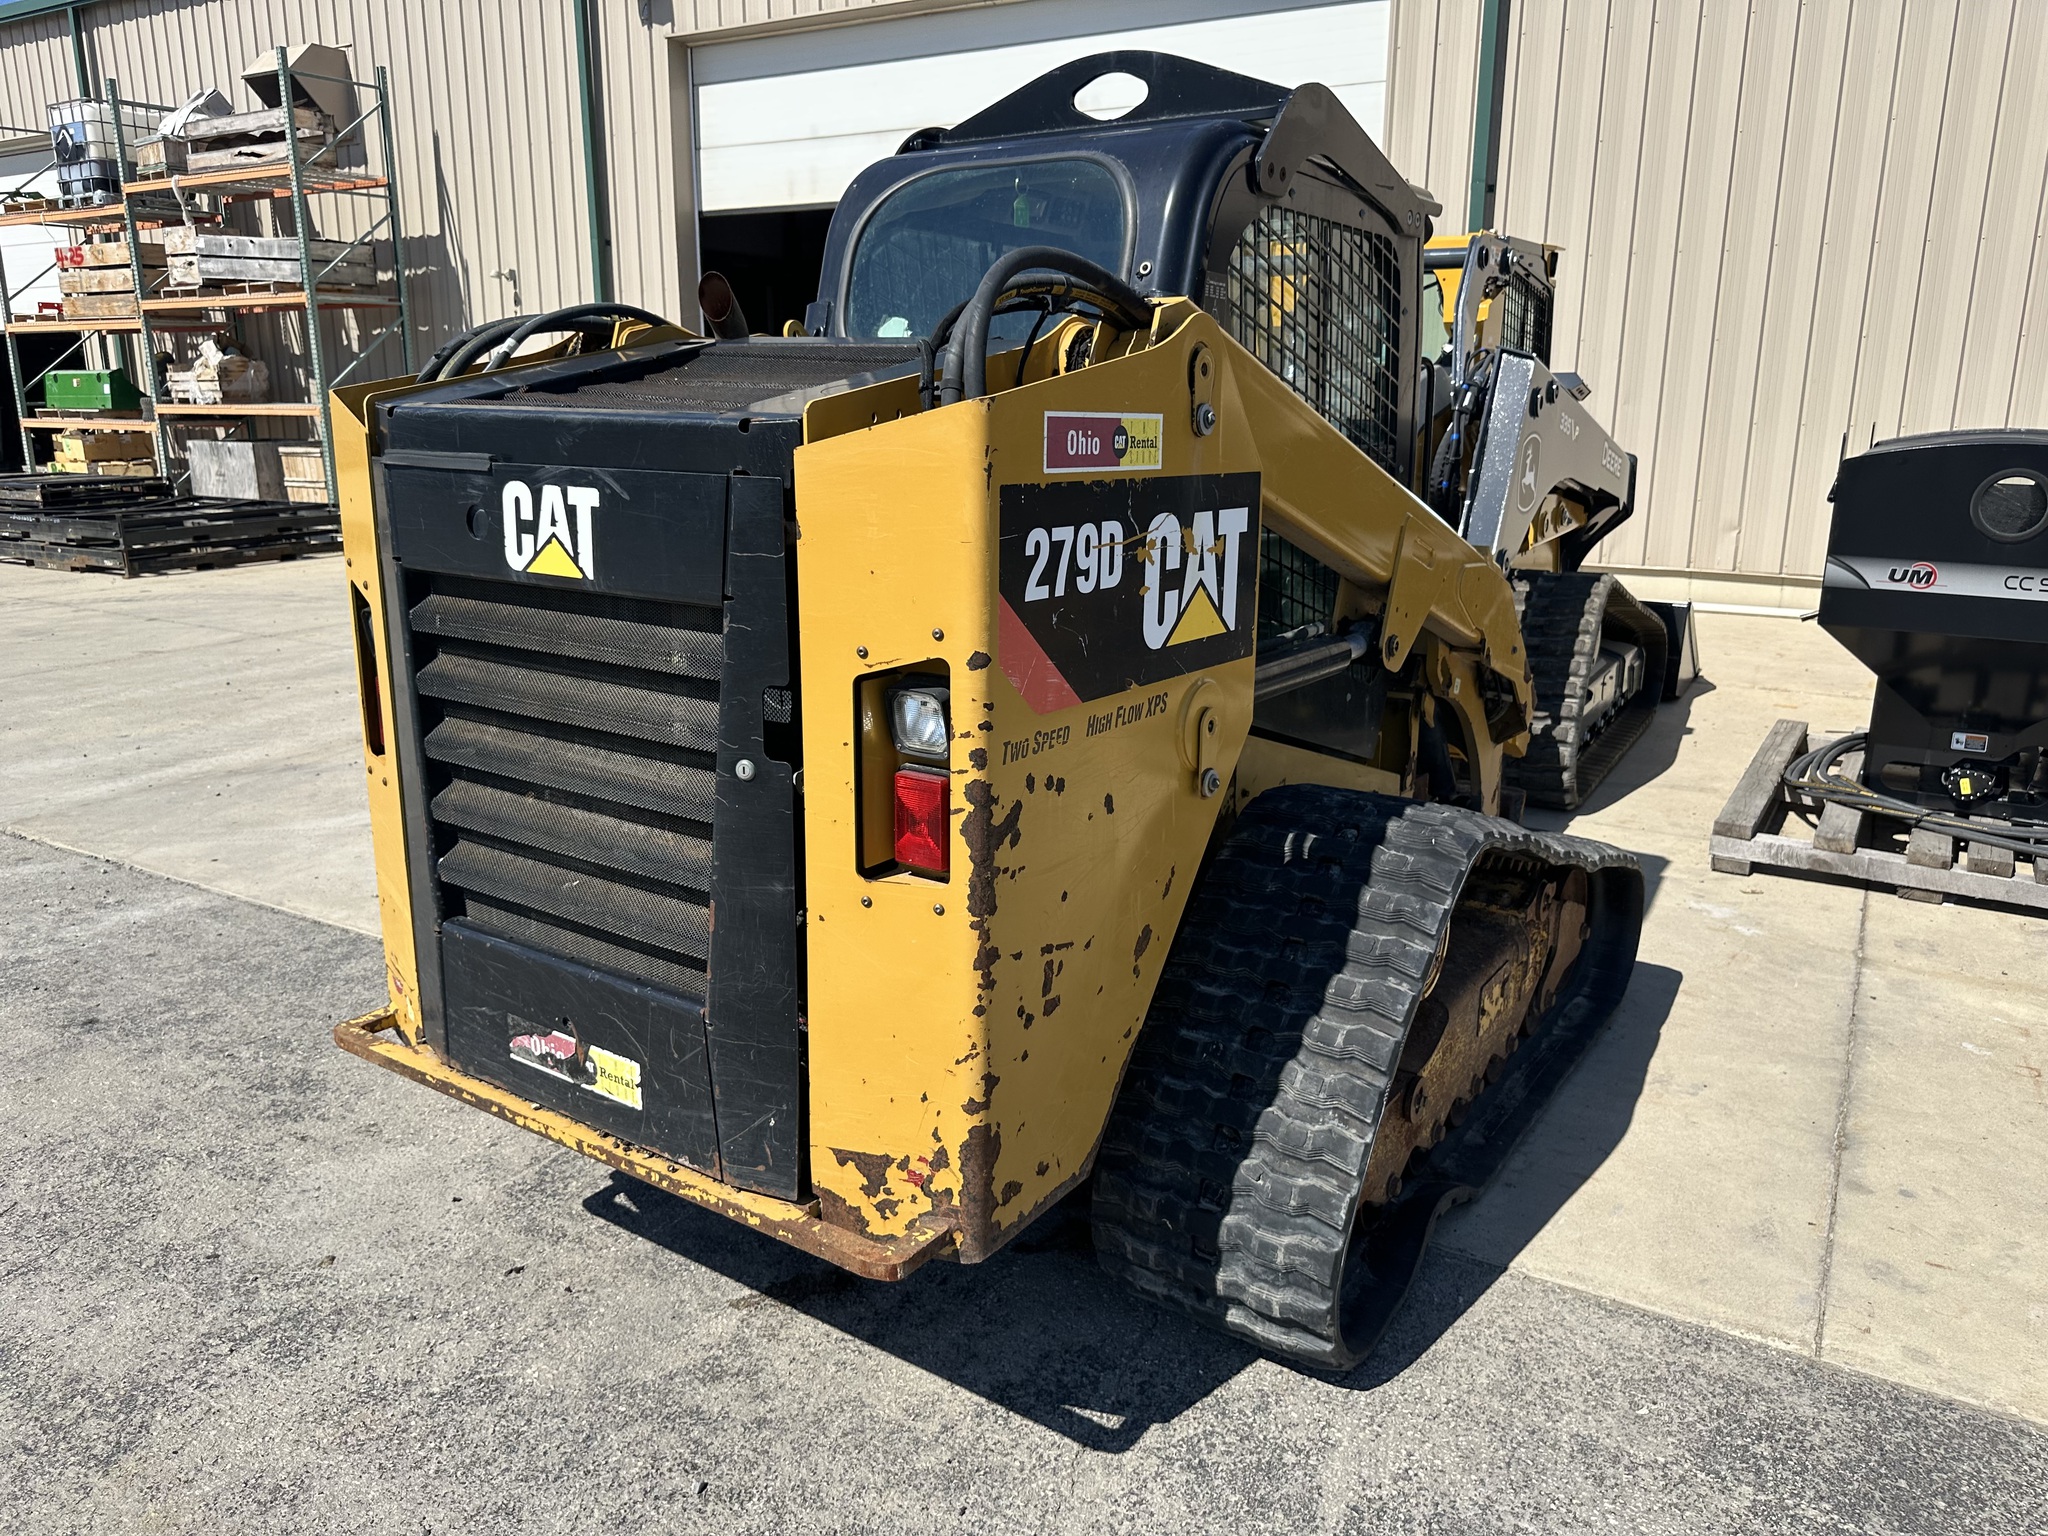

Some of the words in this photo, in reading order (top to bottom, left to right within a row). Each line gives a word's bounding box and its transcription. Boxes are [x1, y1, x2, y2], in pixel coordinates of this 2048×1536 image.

[1067, 429, 1100, 455] Ohio
[1114, 435, 1126, 449] CAT
[1129, 435, 1158, 449] Rental
[1601, 440, 1622, 479] DEERE
[502, 480, 600, 580] CAT
[1024, 520, 1124, 603] 279D
[1143, 507, 1249, 650] CAT
[1887, 566, 1936, 586] UM
[2004, 575, 2034, 592] CC
[1086, 711, 1113, 737] HIGH
[1114, 702, 1144, 728] FLOW
[1145, 691, 1169, 718] XPS
[1032, 725, 1071, 755] SPEED
[599, 1066, 635, 1090] Rental
